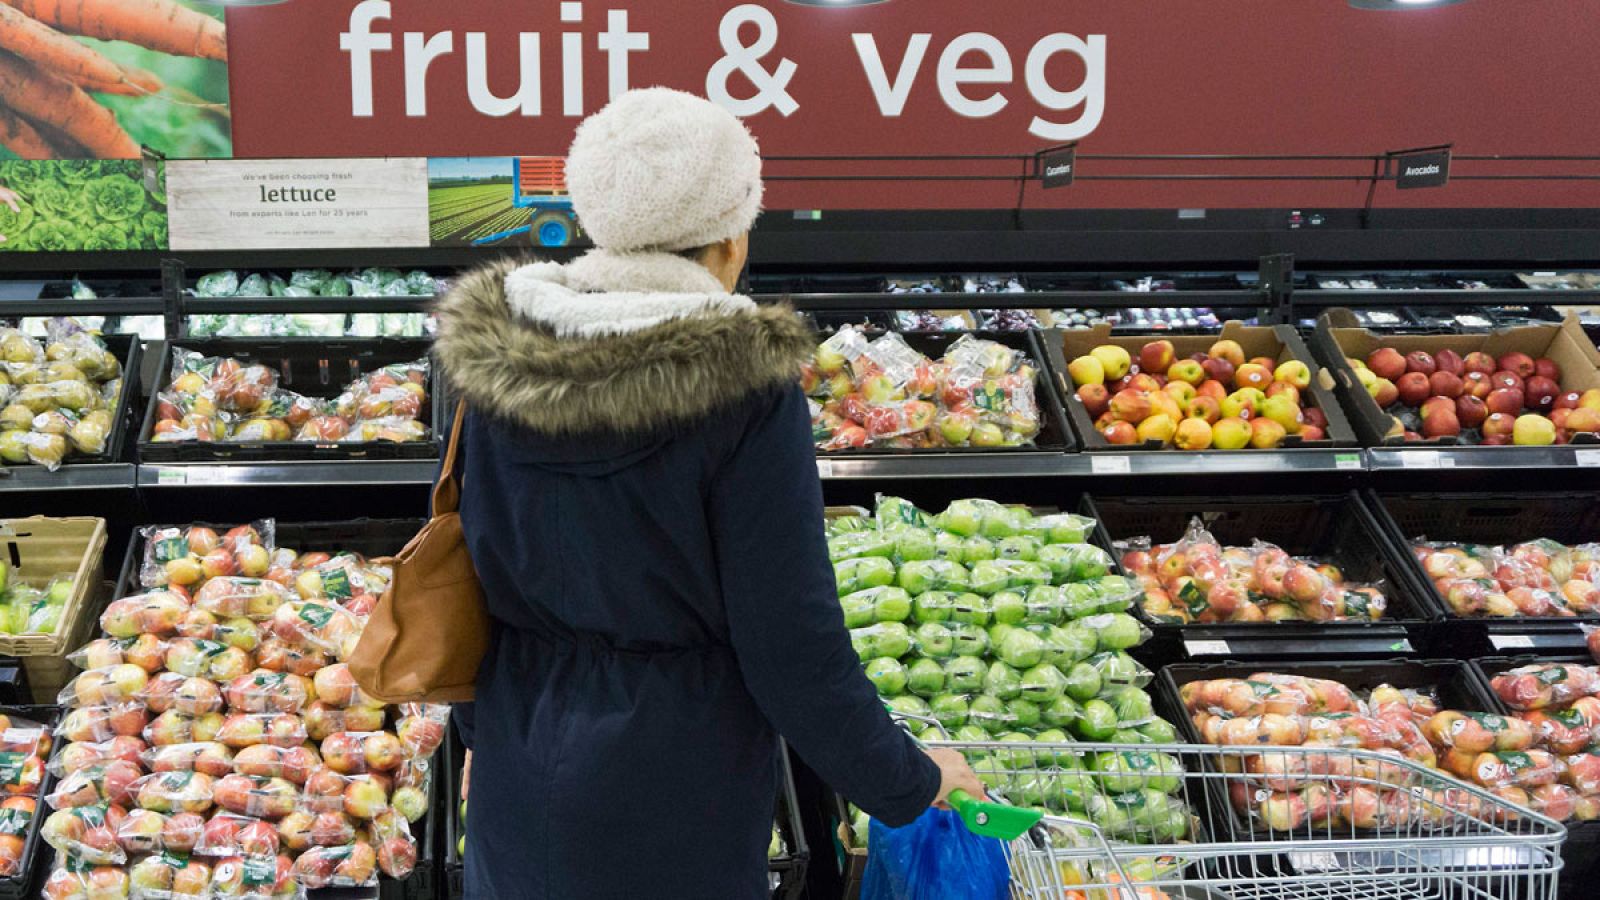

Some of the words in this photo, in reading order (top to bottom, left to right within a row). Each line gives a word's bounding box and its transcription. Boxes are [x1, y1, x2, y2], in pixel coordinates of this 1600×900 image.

[339, 0, 650, 117] fruit
[705, 3, 800, 117] &
[852, 32, 1108, 141] veg
[1405, 164, 1440, 176] Avocados
[268, 173, 290, 181] been
[291, 172, 330, 182] choosing
[331, 171, 353, 180] fresh
[260, 184, 337, 203] lettuce
[229, 210, 249, 218] from
[251, 209, 283, 219] experts
[284, 209, 300, 217] like
[319, 208, 331, 217] for
[346, 208, 368, 218] years
